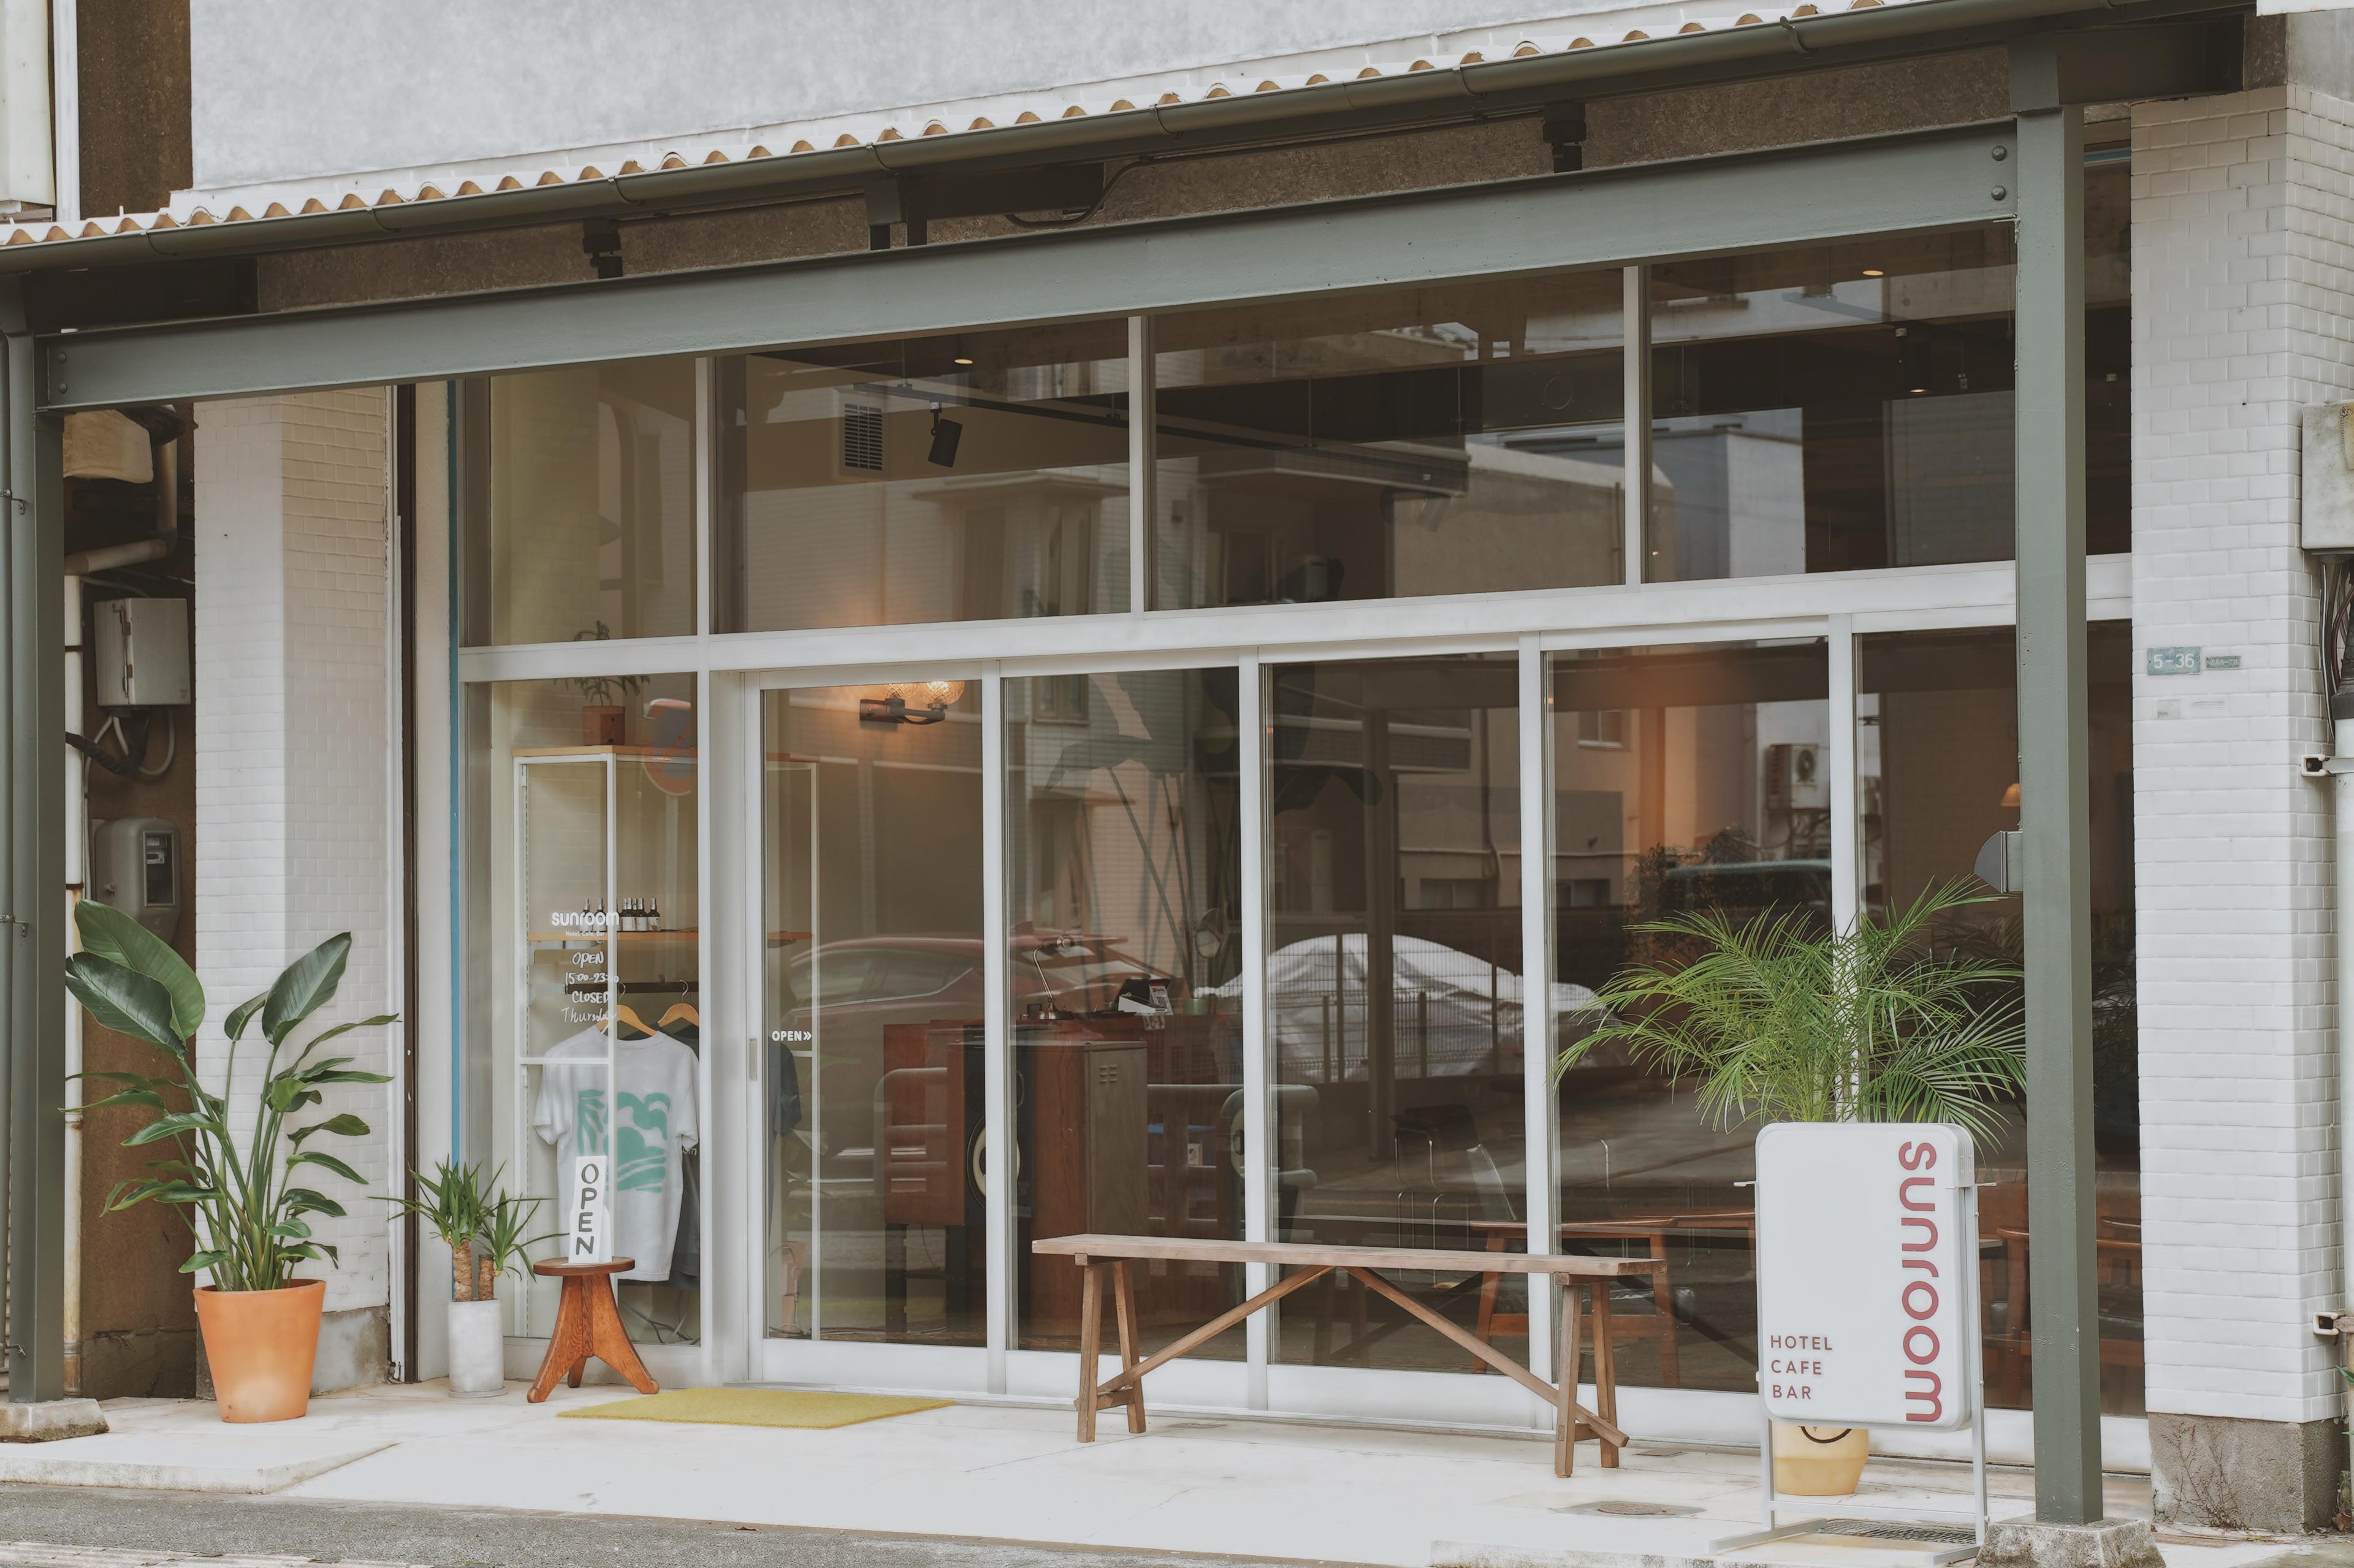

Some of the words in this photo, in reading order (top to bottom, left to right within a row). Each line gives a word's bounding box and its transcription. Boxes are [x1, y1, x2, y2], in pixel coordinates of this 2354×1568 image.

[2154, 653, 2195, 669] 5-36
[552, 911, 619, 926] sunroom
[572, 951, 604, 968] OPEN
[565, 972, 620, 986] 15:00-23:0
[572, 990, 610, 1004] CLOSED
[771, 1030, 802, 1041] OPEN
[576, 1163, 599, 1255] OPEN
[1898, 1141, 1942, 1422] sunroom
[1770, 1335, 1833, 1350] HOTEL
[1771, 1360, 1822, 1375] CAFE
[1772, 1384, 1811, 1399] BAR
